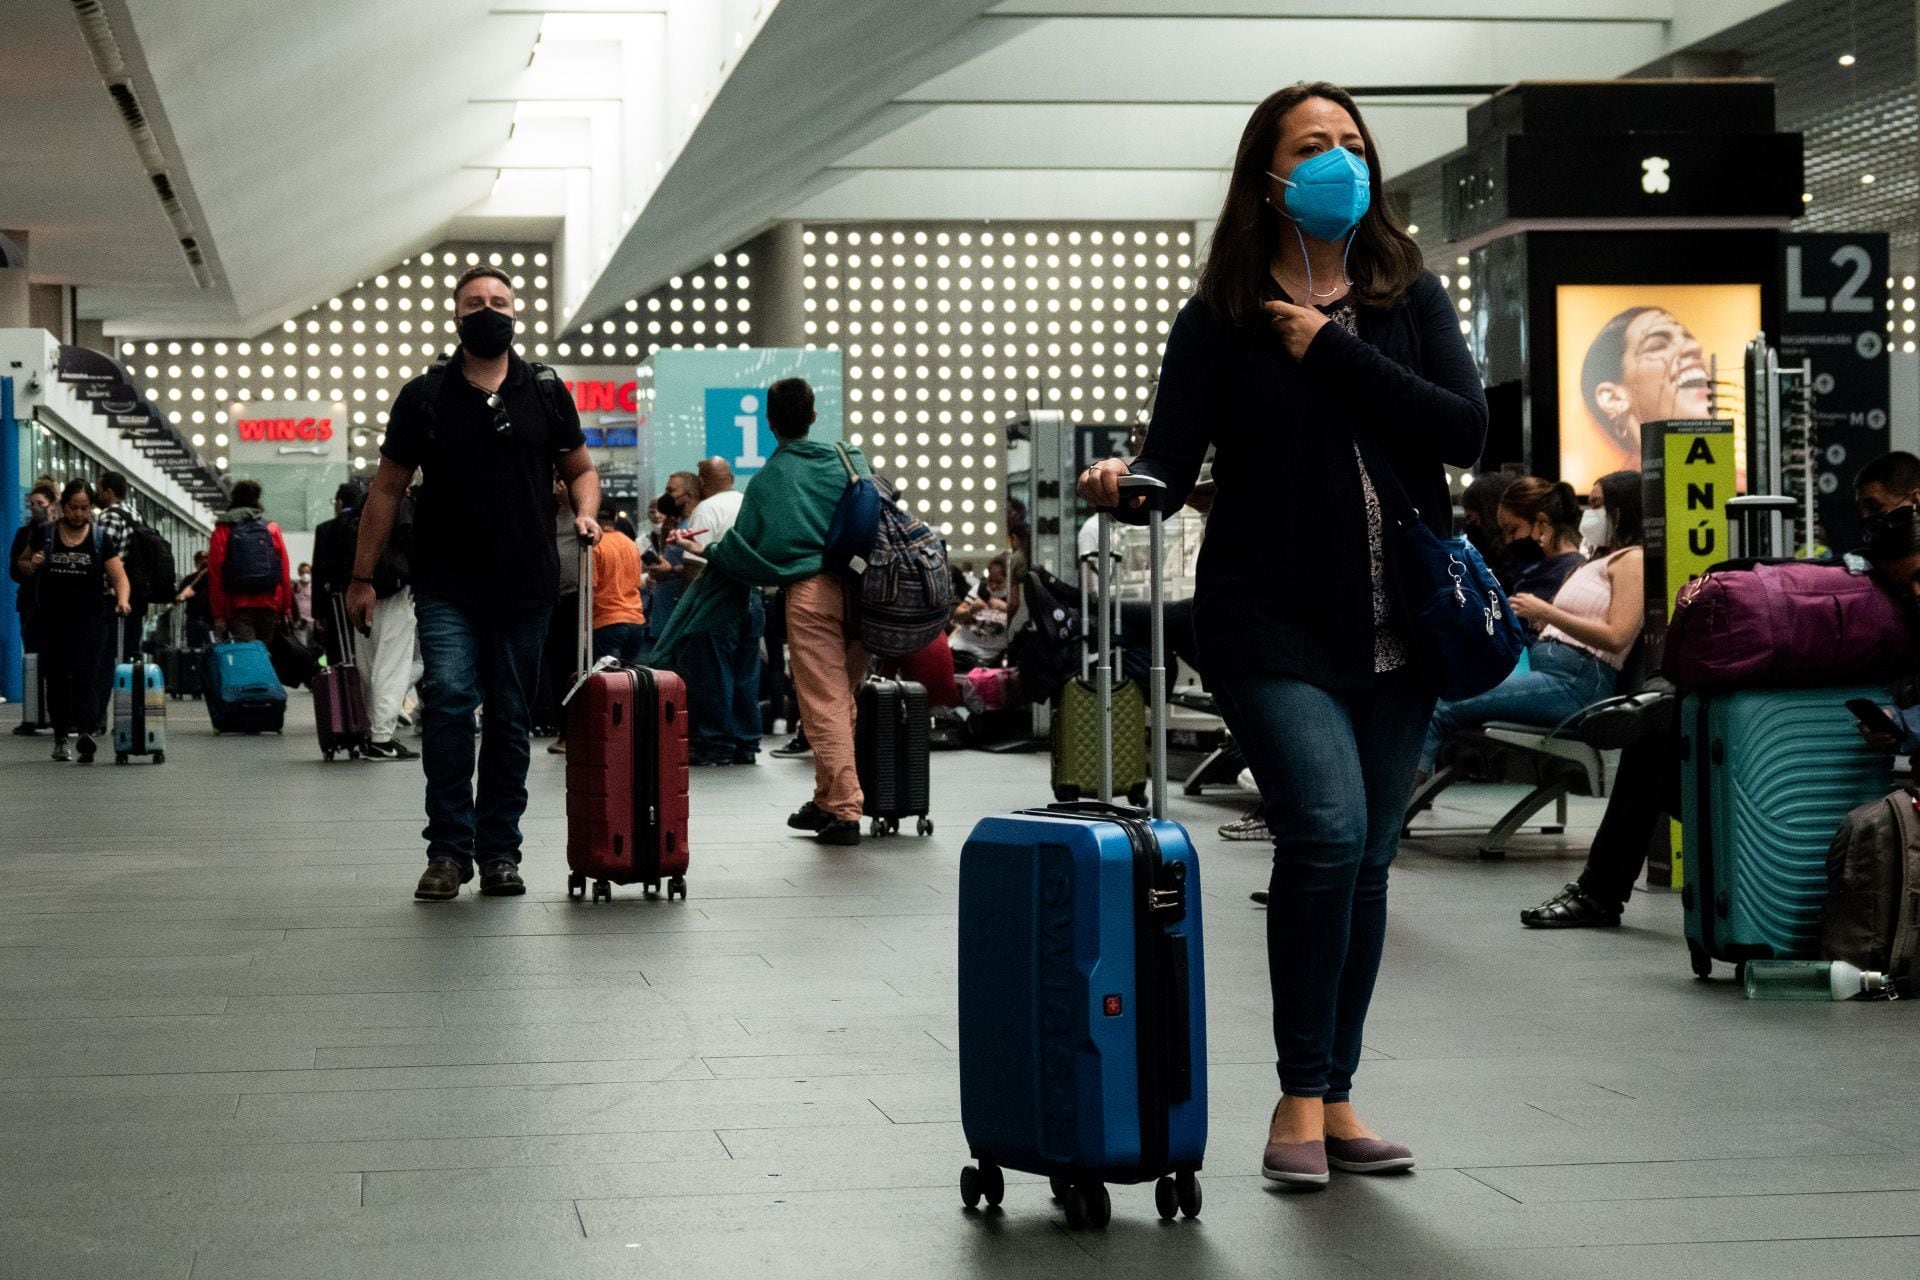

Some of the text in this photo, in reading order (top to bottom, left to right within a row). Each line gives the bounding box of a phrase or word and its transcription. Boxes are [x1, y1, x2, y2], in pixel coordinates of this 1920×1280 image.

[1786, 245, 1874, 313] L2
[563, 381, 638, 413] ING
[238, 418, 333, 442] WINGS
[1084, 431, 1130, 466] L3
